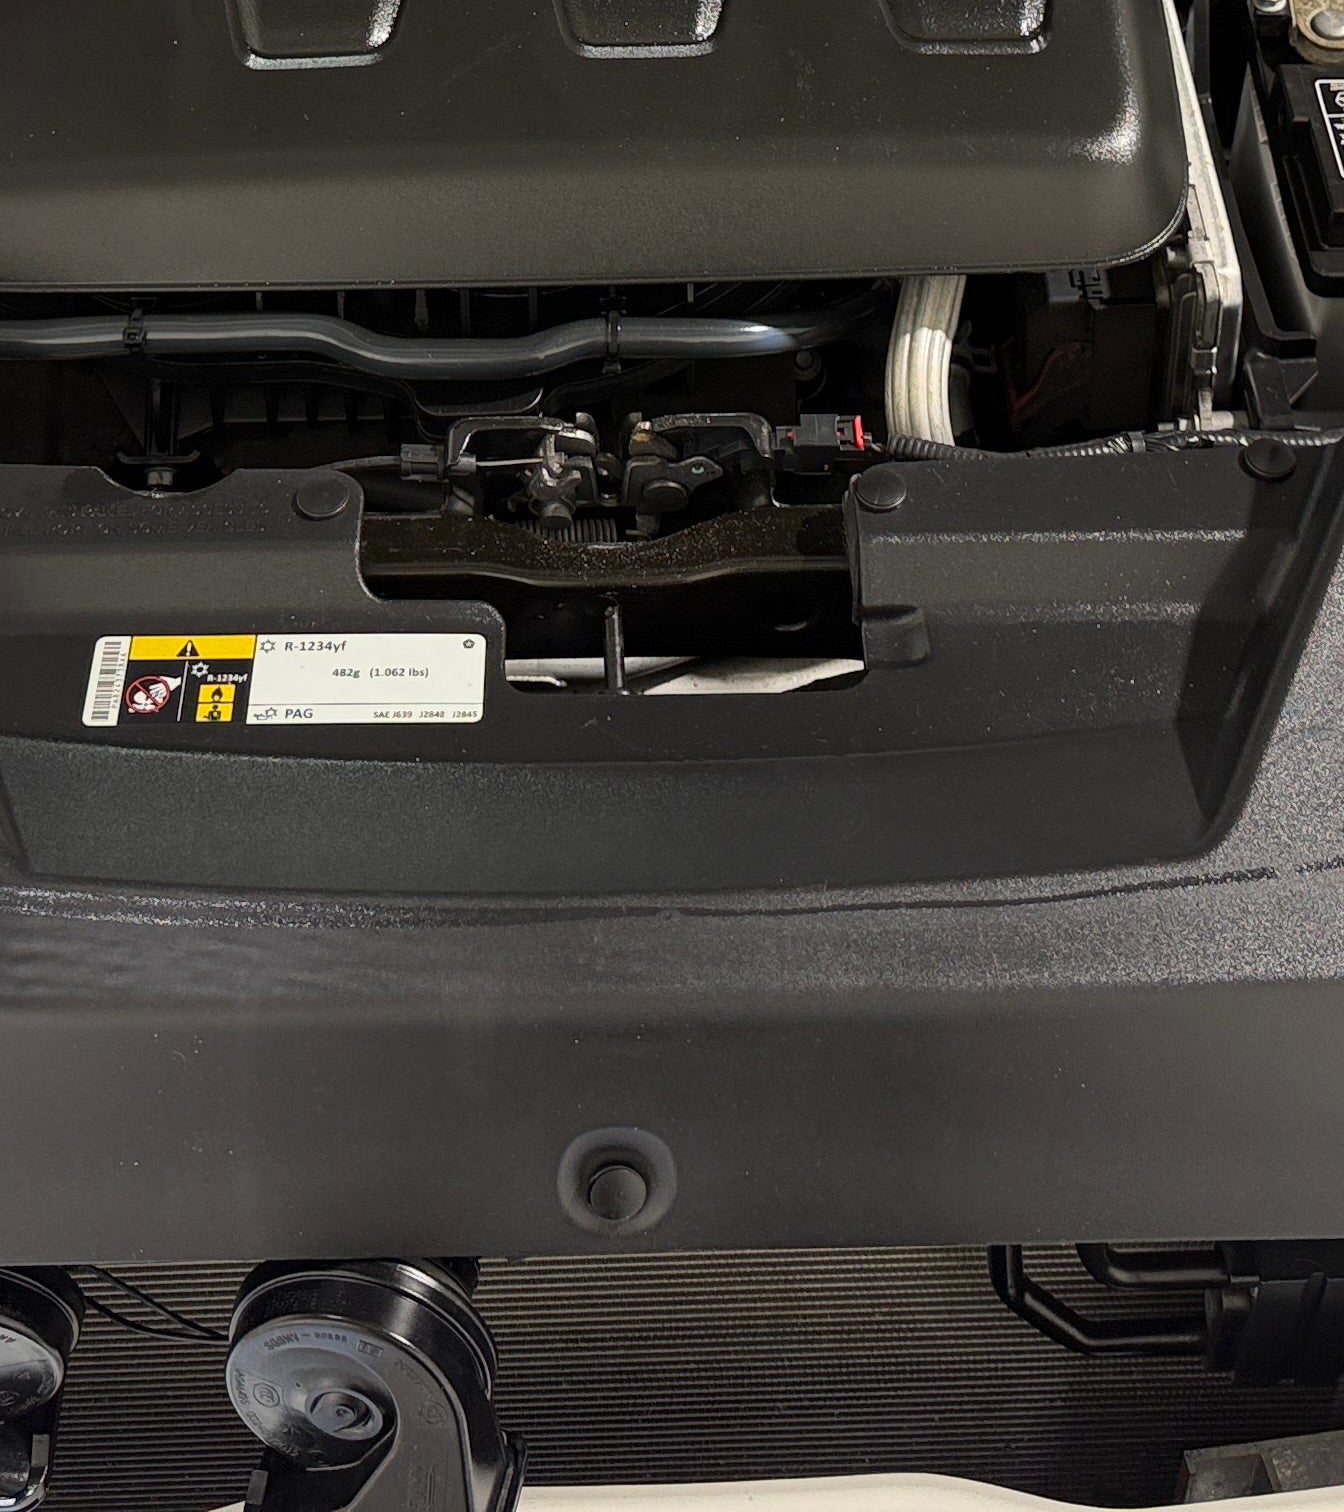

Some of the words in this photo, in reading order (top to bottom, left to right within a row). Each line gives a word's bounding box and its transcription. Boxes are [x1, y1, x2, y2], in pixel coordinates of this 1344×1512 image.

[285, 641, 347, 653] R-1234yf
[332, 669, 360, 678] 482g
[370, 668, 405, 678] (1.062
[409, 668, 429, 678] lbs)
[207, 674, 248, 683] R-1234yf
[285, 709, 313, 719] PAG
